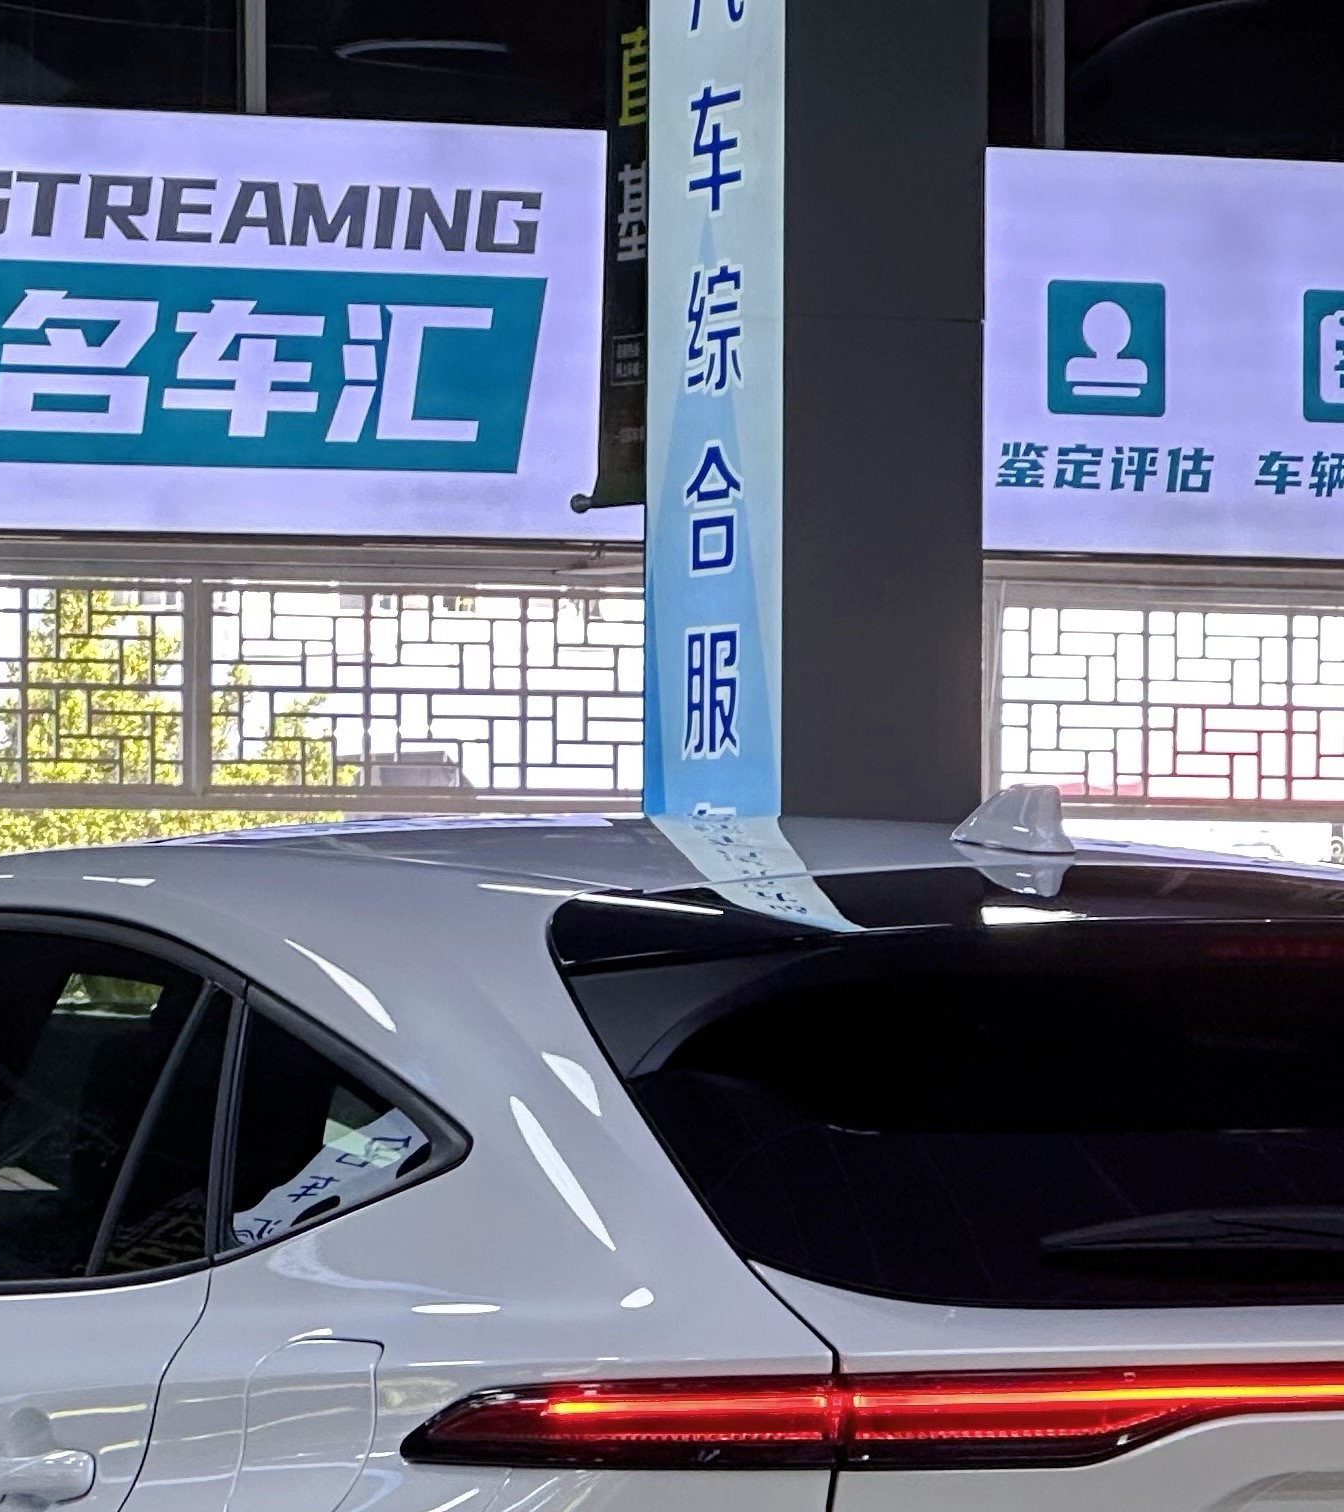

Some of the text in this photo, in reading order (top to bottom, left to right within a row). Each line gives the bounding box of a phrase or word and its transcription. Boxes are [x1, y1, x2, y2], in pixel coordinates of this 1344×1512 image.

[686, 0, 745, 820] 车综合服
[995, 441, 1215, 494] 鉴定评估
